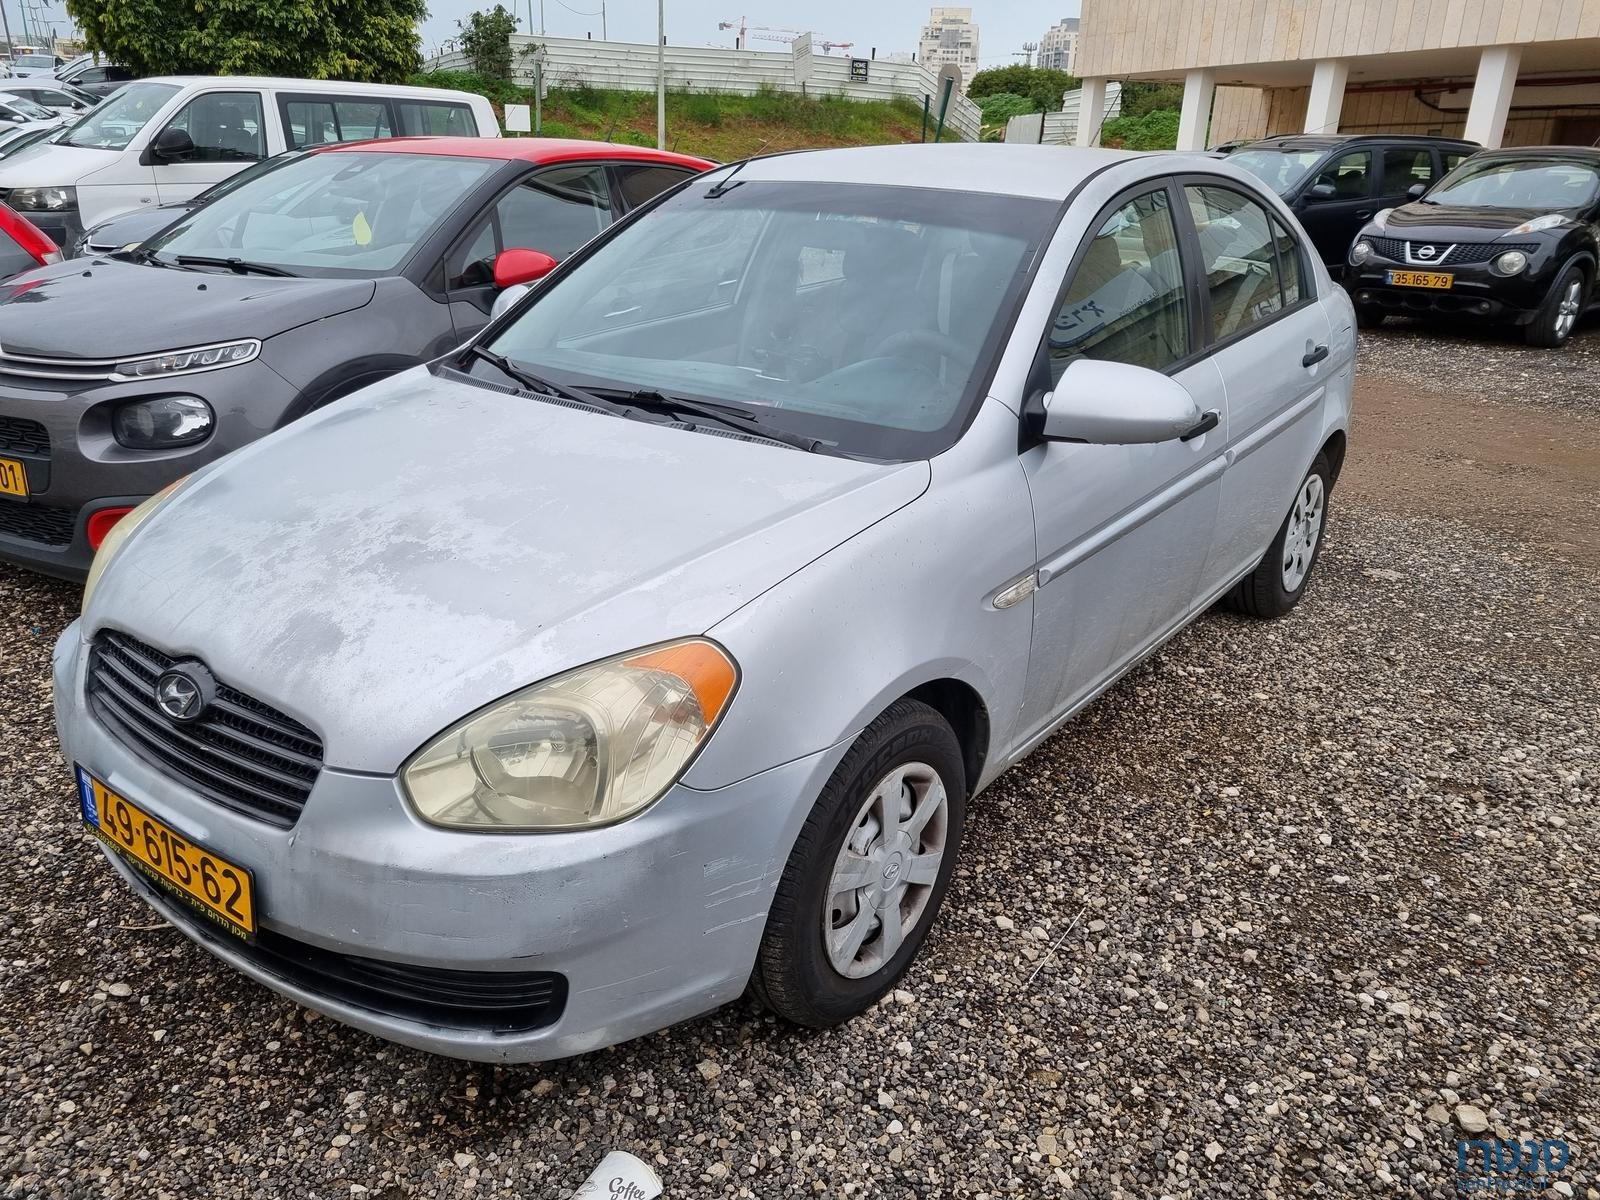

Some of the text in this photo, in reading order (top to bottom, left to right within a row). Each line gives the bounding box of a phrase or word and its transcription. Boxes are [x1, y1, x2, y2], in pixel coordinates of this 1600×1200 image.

[207, 909, 230, 928] הדרום
[231, 924, 247, 940] מכון
[608, 1177, 646, 1200] Coffee
